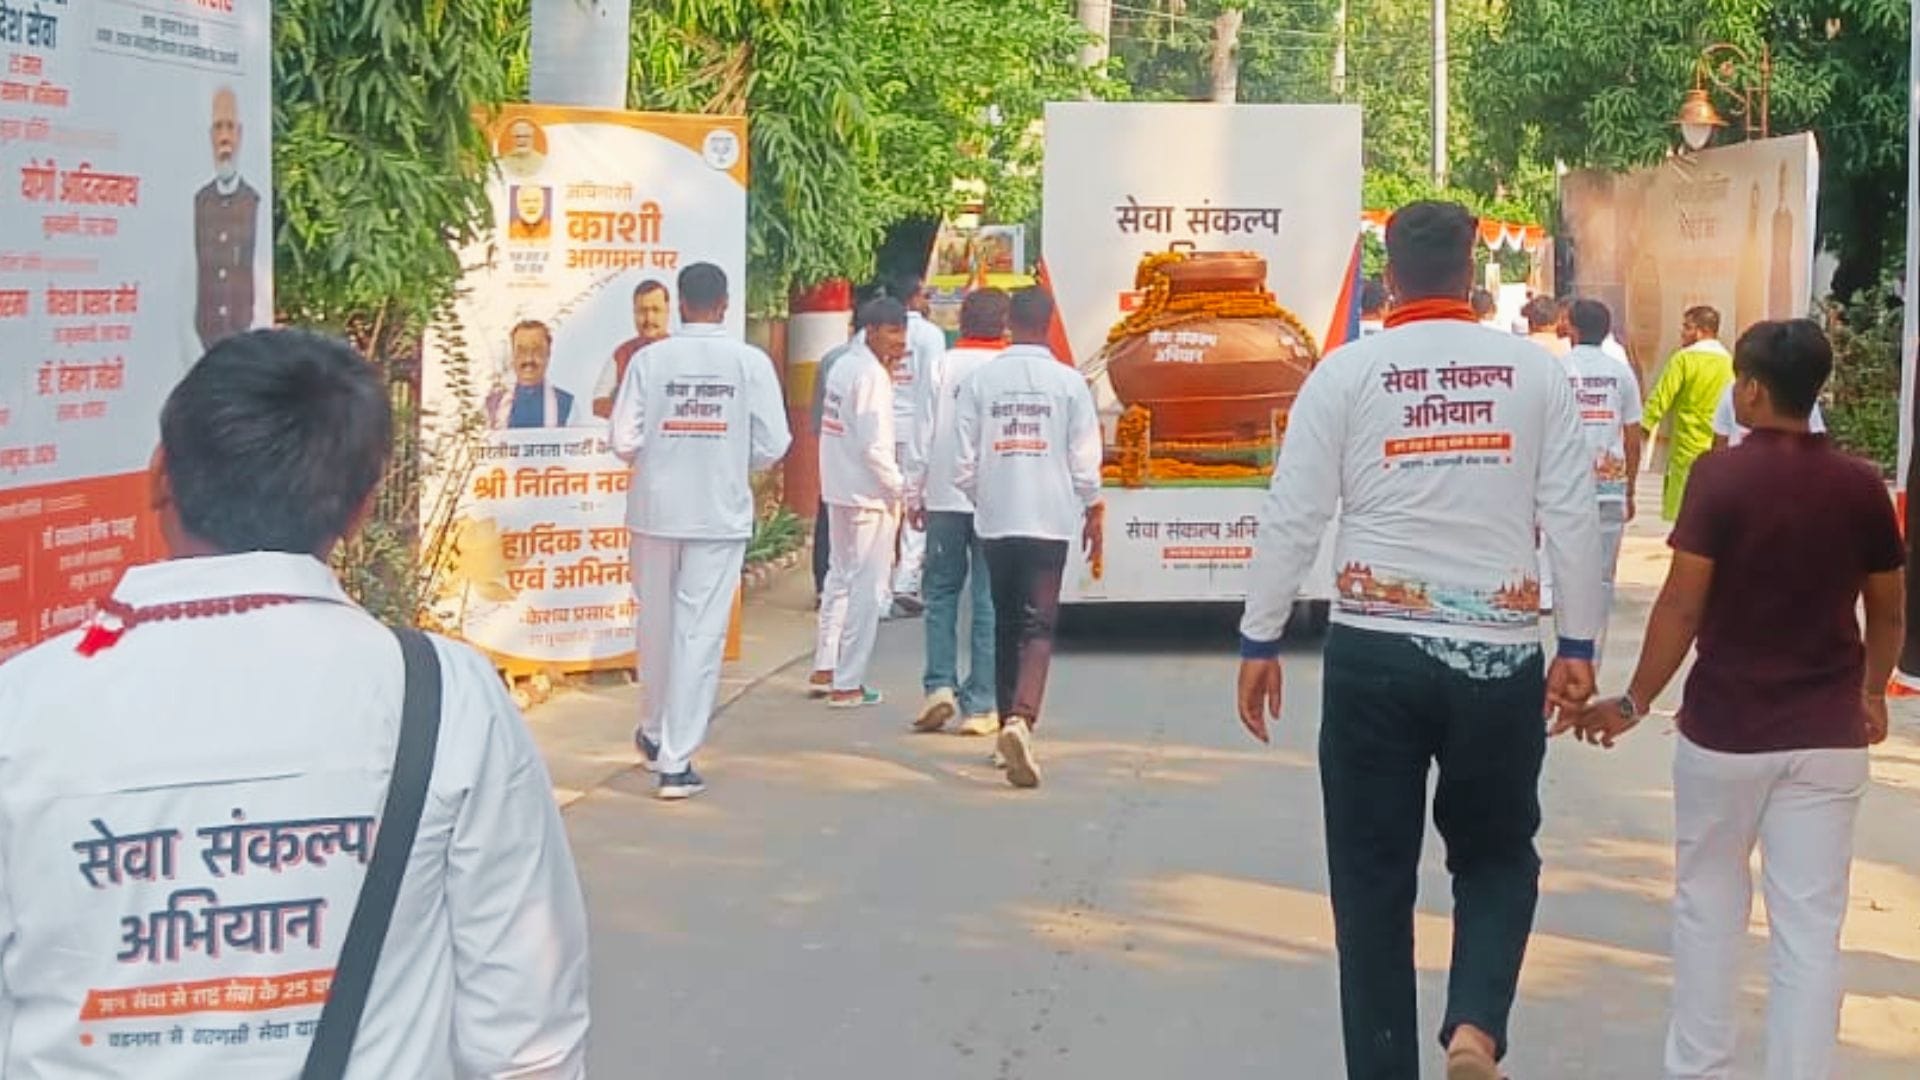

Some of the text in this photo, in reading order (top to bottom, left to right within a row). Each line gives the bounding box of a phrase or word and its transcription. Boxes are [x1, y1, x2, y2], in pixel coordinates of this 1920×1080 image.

[565, 201, 662, 244] काशी
[1115, 194, 1283, 235] सेवा संकल्प
[565, 249, 645, 270] आगमन
[652, 250, 678, 269] पर
[1381, 360, 1515, 393] सेवा संकल्प
[1402, 393, 1495, 429] अभियान
[473, 466, 507, 499] श्री
[514, 465, 590, 498] नितिन
[501, 522, 630, 560] हार्दिक स्वा
[1125, 514, 1260, 540] सेवा संकल्प अभि
[506, 555, 633, 592] एवं अभिनं
[73, 807, 378, 890] सेवा संकल्प
[116, 887, 329, 965] अभियान
[259, 977, 281, 1001] के
[283, 979, 308, 999] 25
